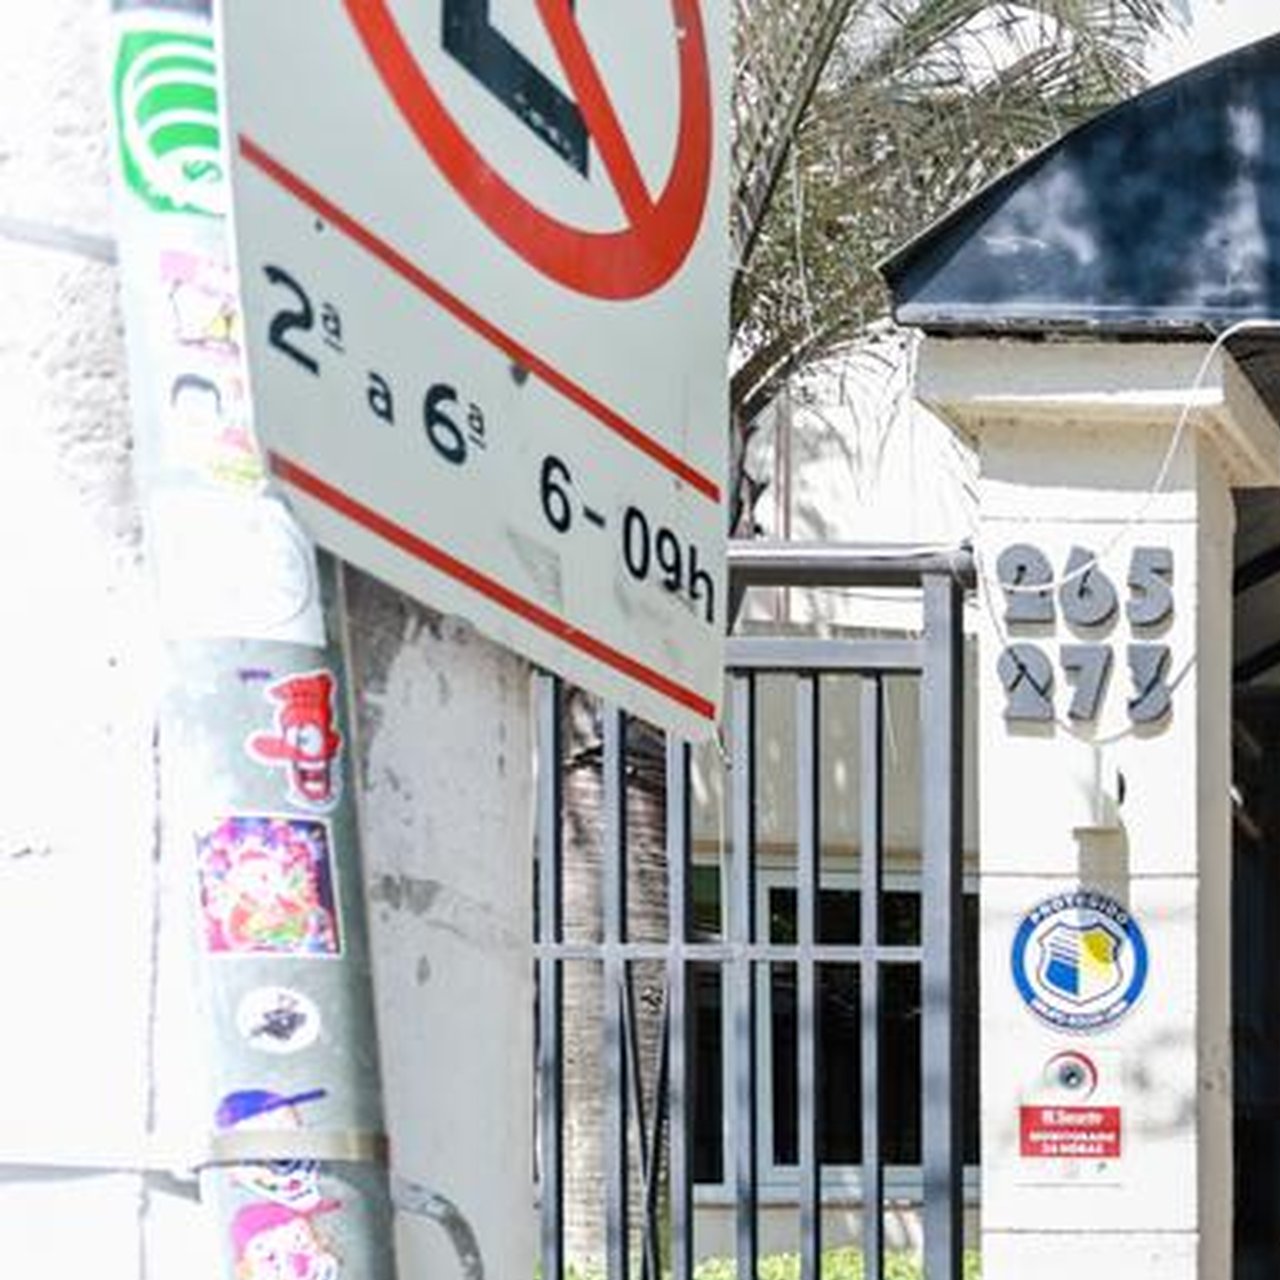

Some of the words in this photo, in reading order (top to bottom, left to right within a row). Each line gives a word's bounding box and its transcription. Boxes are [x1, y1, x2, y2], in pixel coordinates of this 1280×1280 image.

[366, 369, 395, 427] a
[996, 543, 1175, 630] 265
[996, 643, 1174, 724] 273
